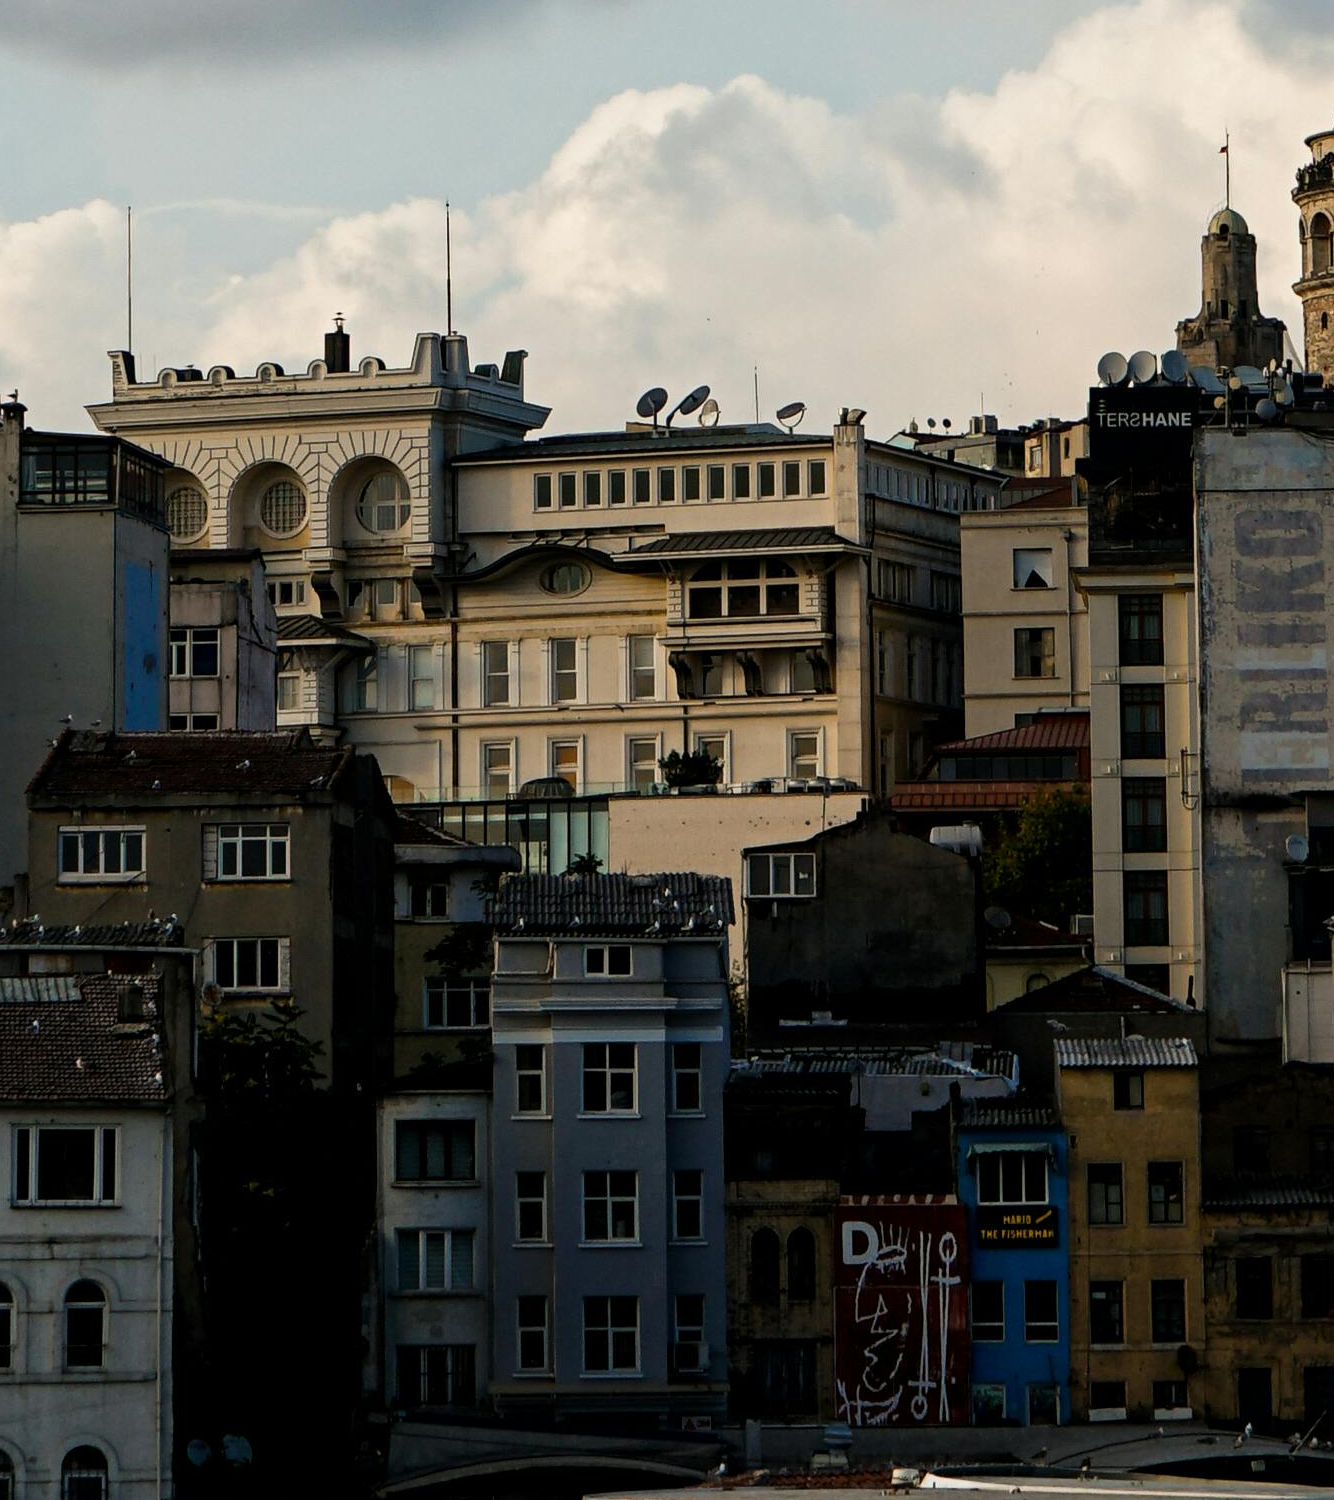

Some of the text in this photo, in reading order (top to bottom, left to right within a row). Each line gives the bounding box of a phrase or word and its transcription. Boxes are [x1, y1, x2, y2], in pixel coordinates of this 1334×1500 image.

[1095, 411, 1193, 428] TERSHANE
[1002, 1214, 1032, 1225] MARIO
[980, 1228, 1055, 1240] THE FISHERMAN
